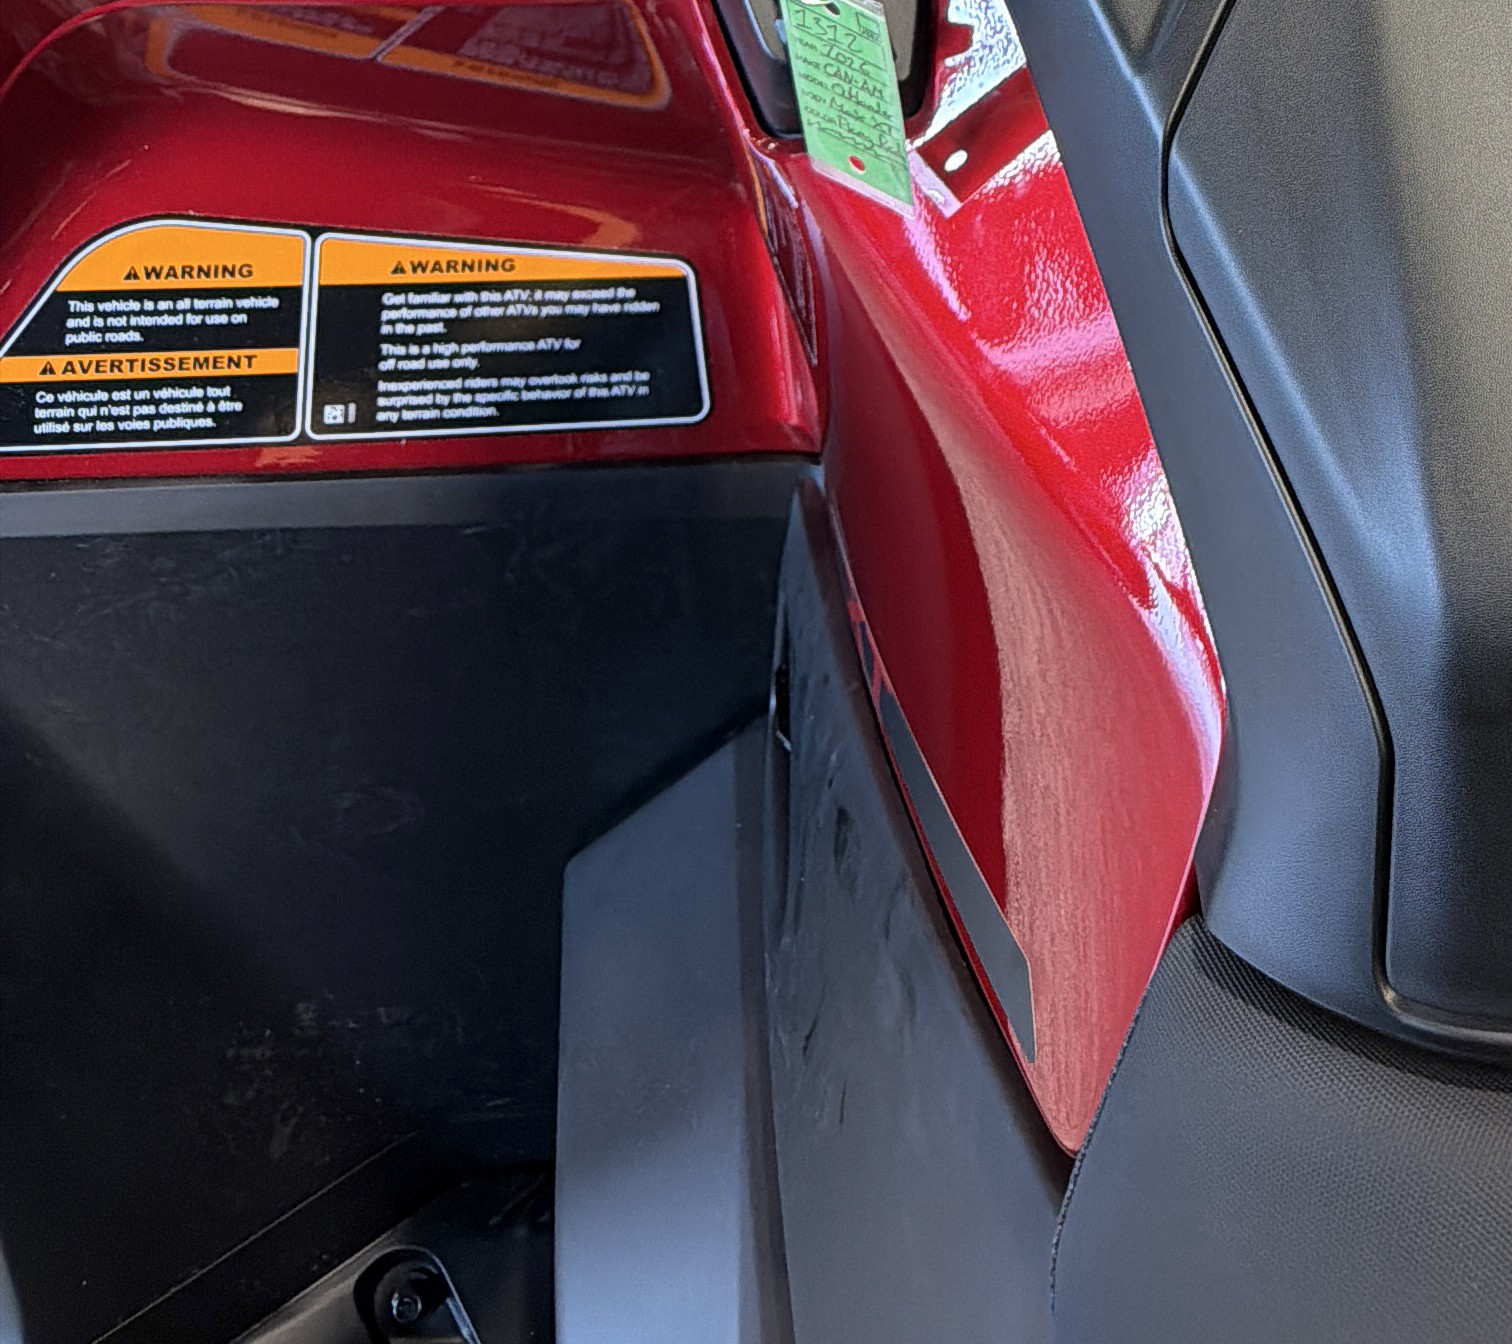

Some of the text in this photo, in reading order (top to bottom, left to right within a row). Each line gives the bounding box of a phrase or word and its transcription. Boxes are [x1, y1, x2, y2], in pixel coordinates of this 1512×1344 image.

[794, 8, 863, 53] 1312
[823, 62, 885, 100] CAN-AM
[143, 263, 253, 280] WARNING
[409, 258, 515, 274] WARNING
[67, 295, 279, 312] This vehicle is an all terrain vehicle
[65, 312, 247, 328] and is not intended for use on
[64, 329, 144, 346] public roads.
[379, 337, 581, 356] This is a high performance ATV for
[61, 354, 257, 375] AVERTISSEMENT
[35, 385, 231, 403] Ce véhicule est un véhicule tout
[34, 399, 243, 419] terrain qui n'est pas destiné à être
[33, 416, 216, 434] utilisé sur les voies publiques.
